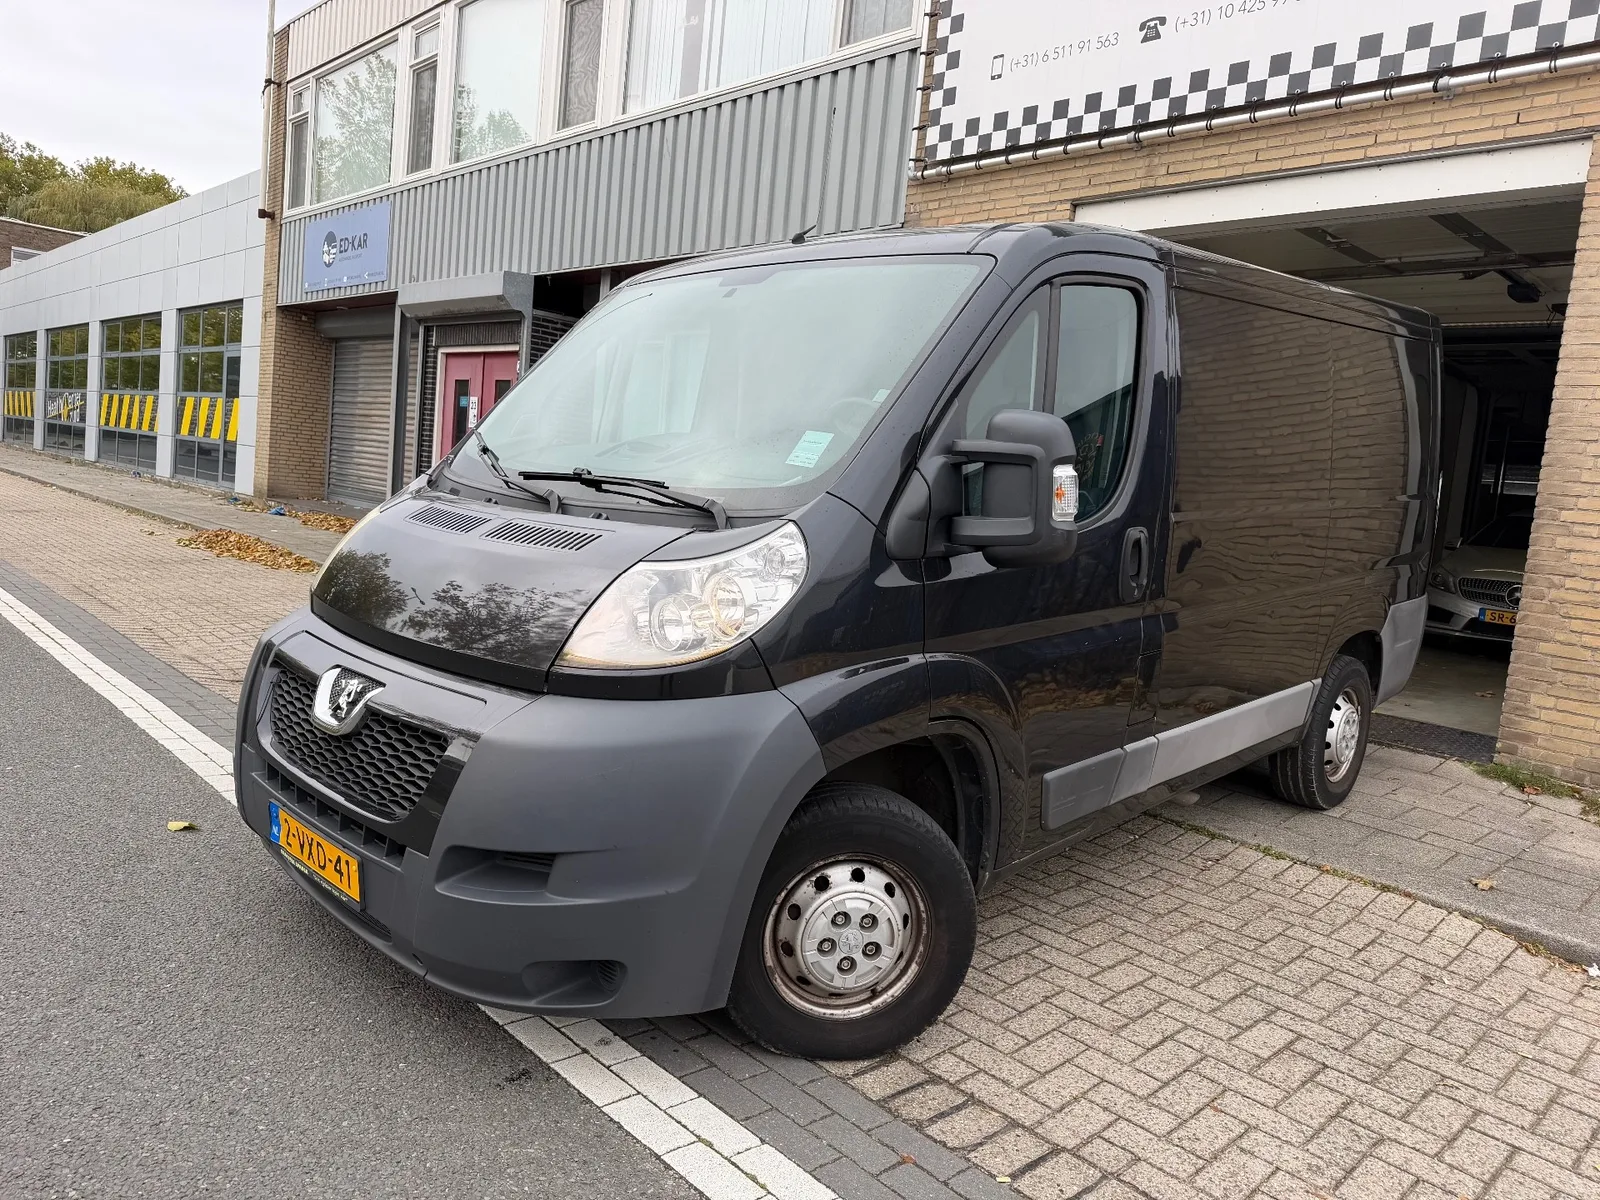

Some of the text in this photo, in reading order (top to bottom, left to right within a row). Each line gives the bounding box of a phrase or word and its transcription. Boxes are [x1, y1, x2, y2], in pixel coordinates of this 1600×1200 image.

[1174, 9, 1212, 33] (+31)
[1217, 3, 1234, 20] 10
[1009, 31, 1120, 73] (+31) 6 511 91 563
[284, 817, 352, 890] 2-VXD-41
